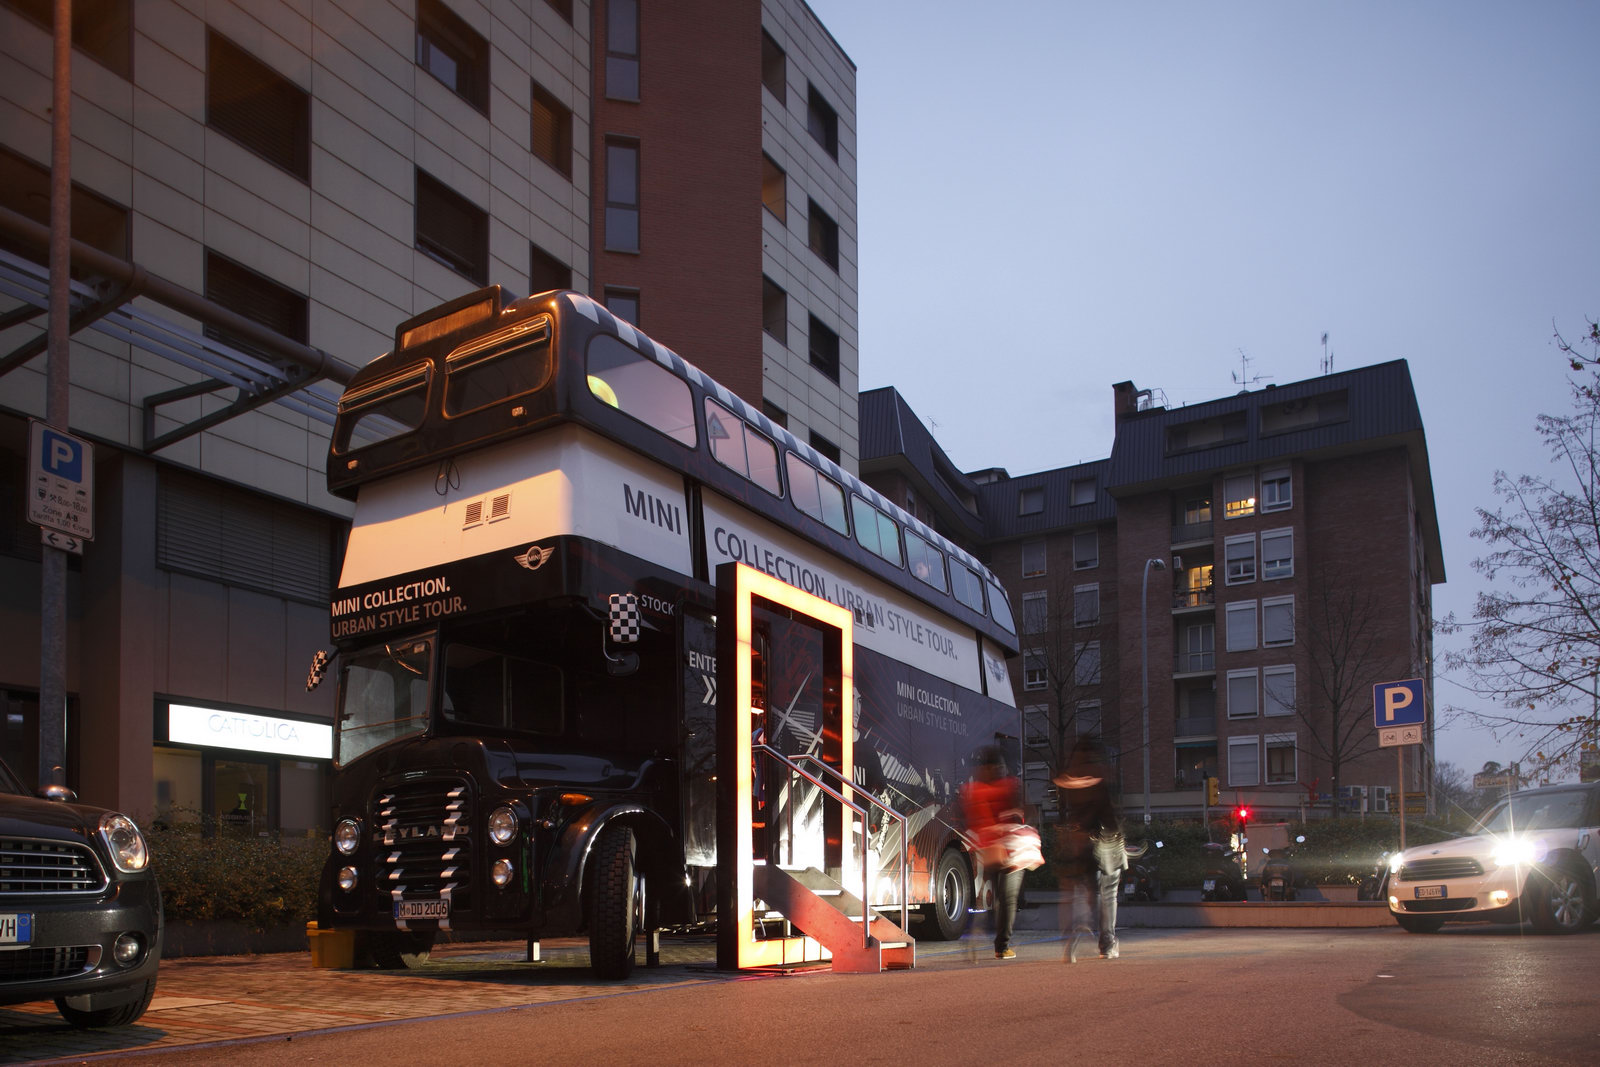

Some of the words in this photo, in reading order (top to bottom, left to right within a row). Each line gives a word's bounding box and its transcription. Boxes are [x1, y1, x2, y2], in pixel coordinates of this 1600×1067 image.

[50, 438, 74, 470] P
[42, 504, 62, 517] Zone
[623, 482, 682, 536] MINI
[714, 527, 831, 603] COLLECTION.
[835, 583, 885, 627] URBAN
[887, 610, 924, 645] STYLE
[925, 628, 958, 661] TOUR.
[331, 596, 360, 617] MINI
[364, 576, 451, 610] COLLECTION.
[641, 594, 675, 617] STOCK
[332, 614, 376, 638] URBAN
[379, 605, 420, 628] STYLE
[423, 595, 467, 619] TOUR.
[689, 649, 717, 674] ENTE
[896, 680, 915, 701] MINI
[916, 688, 962, 717] COLLECTION.
[1384, 686, 1414, 721] P
[208, 713, 300, 742] CATTOLICA
[897, 701, 924, 725] URBAN
[925, 711, 947, 731] STYLE
[948, 718, 969, 737] TOUR.
[373, 825, 470, 841] LEYLAND
[399, 903, 406, 915] M
